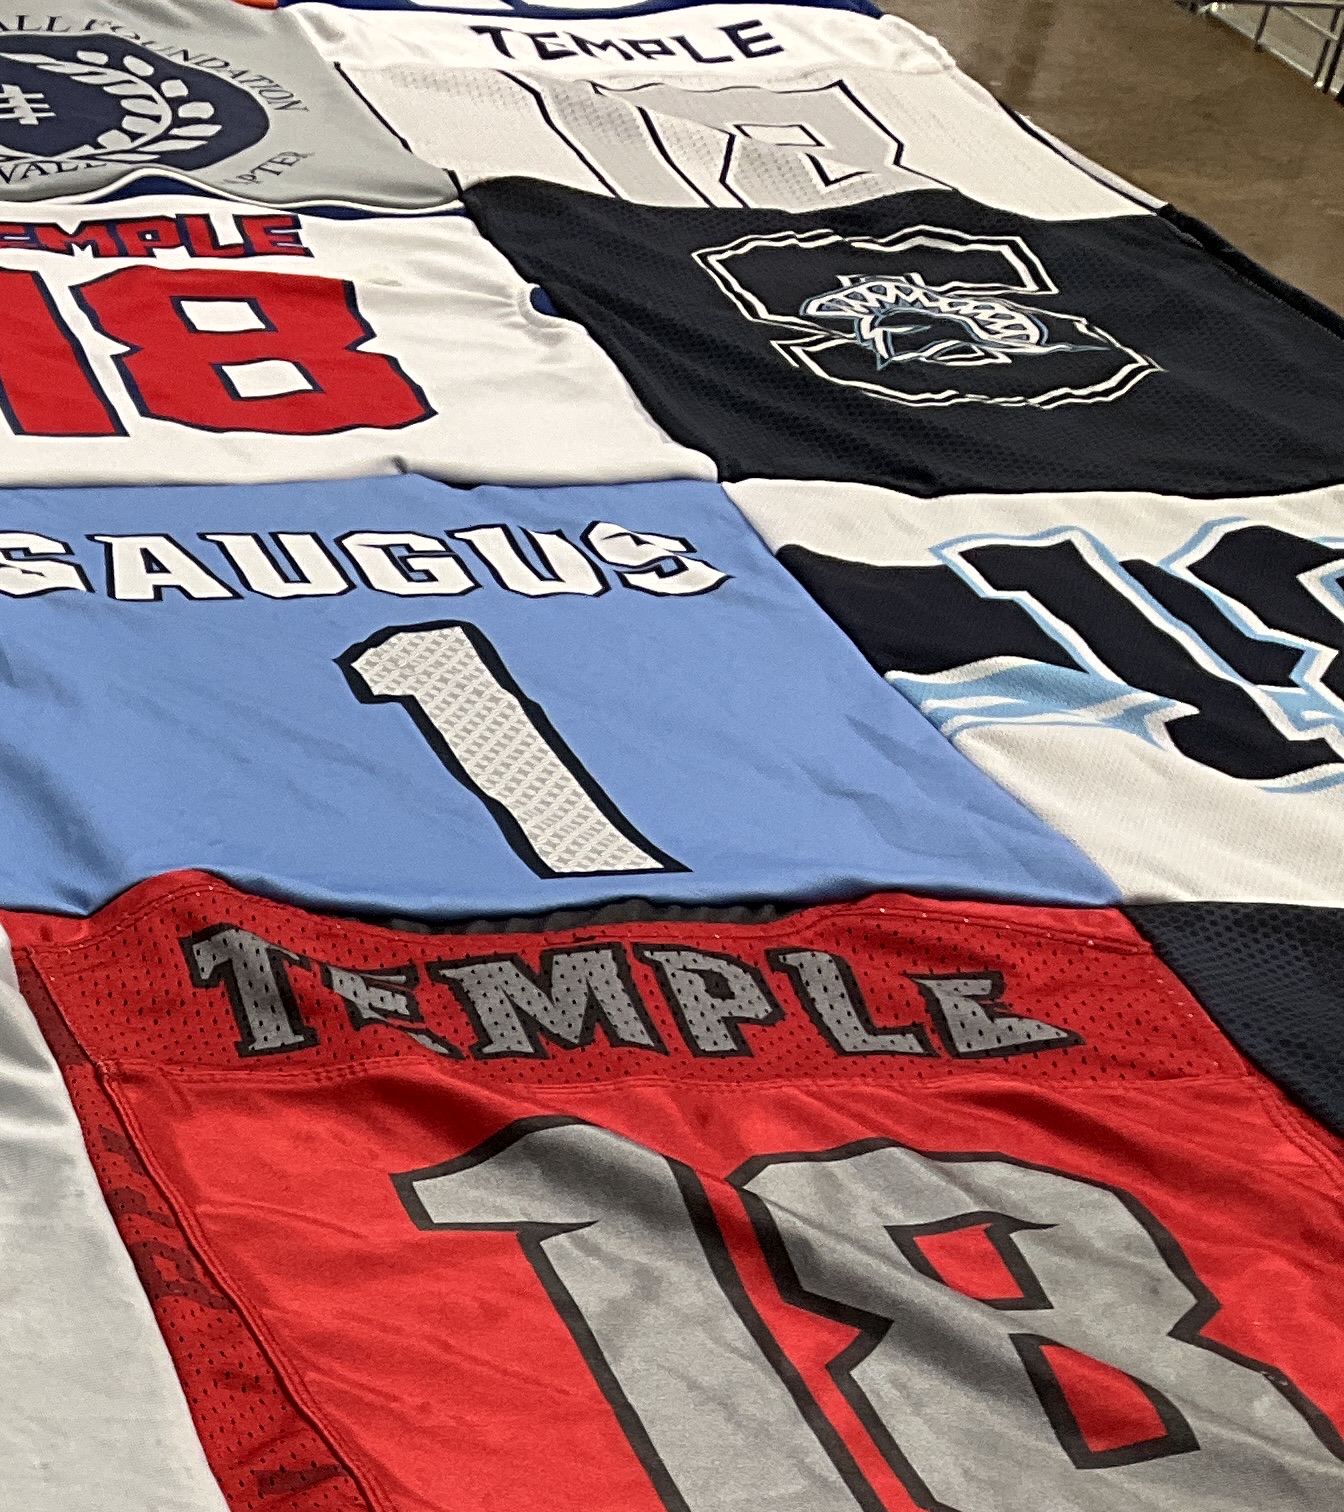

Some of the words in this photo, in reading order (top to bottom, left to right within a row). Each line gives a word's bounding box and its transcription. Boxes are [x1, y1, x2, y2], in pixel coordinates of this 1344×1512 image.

[470, 19, 788, 62] TEMPLE
[332, 619, 693, 879] 1
[180, 920, 1088, 1063] TEMPLE
